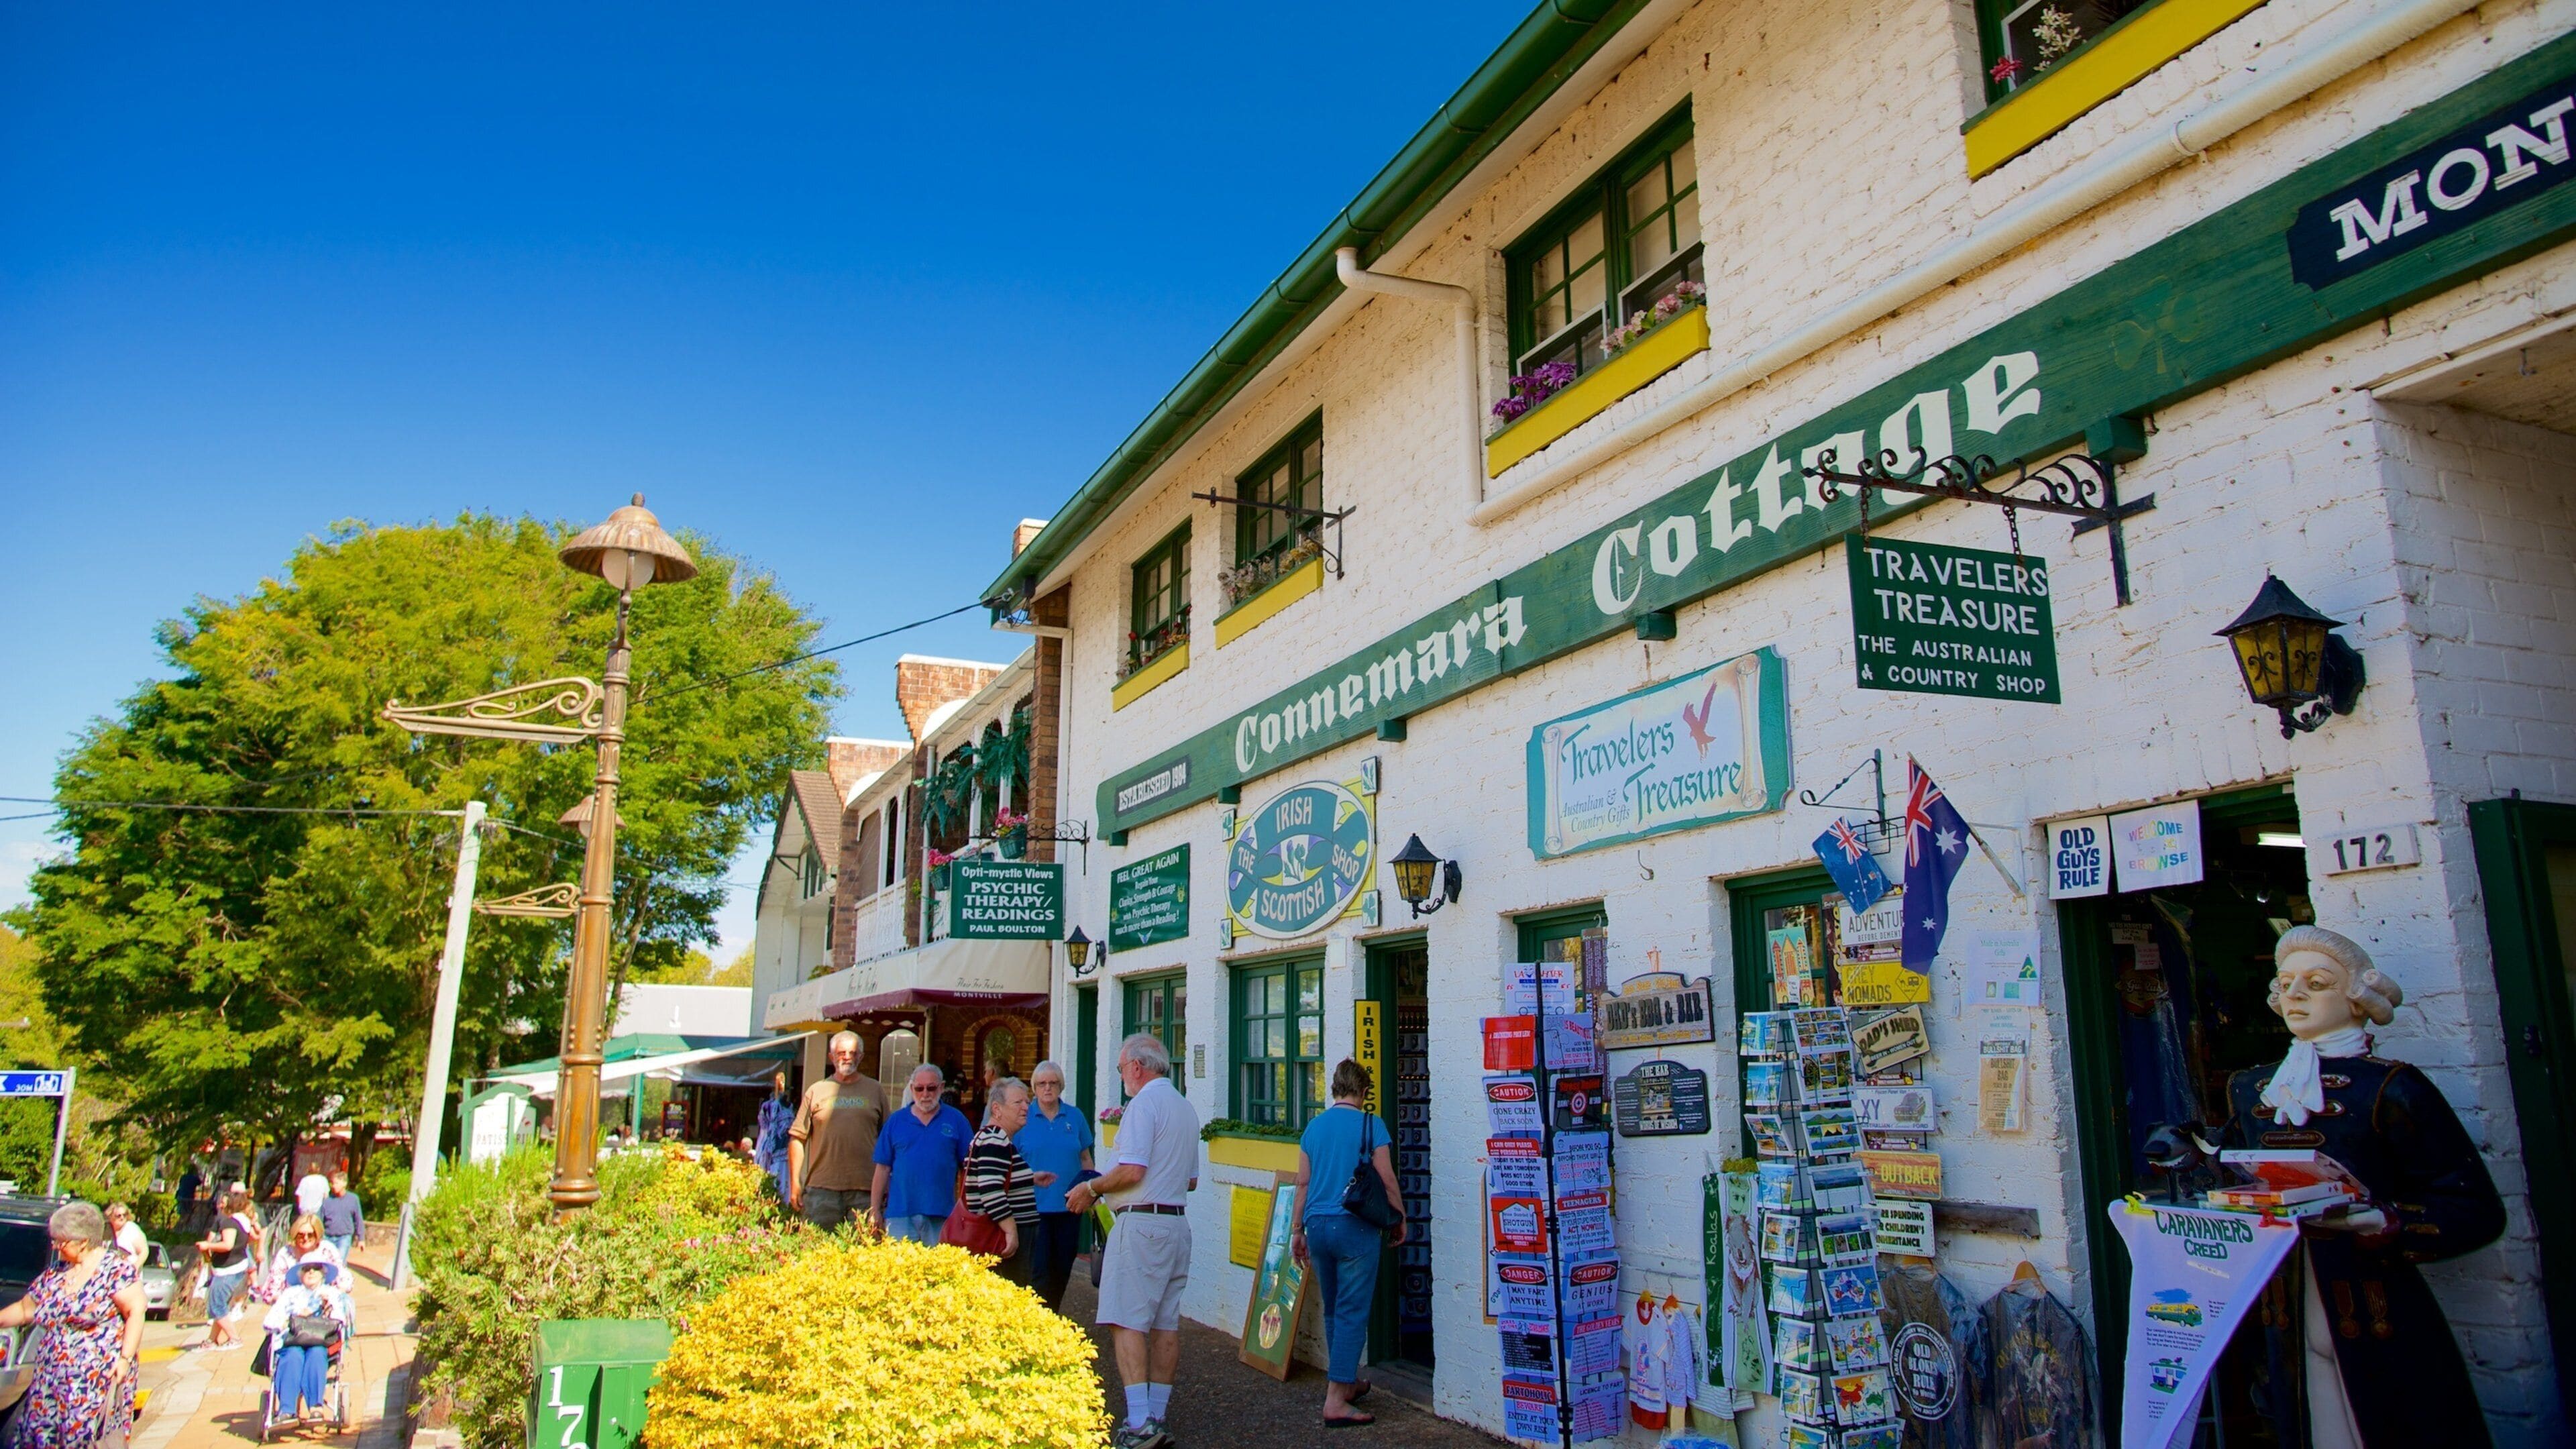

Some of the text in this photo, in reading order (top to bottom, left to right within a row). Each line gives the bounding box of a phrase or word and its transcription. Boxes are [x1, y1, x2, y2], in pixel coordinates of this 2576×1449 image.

[2330, 96, 2576, 262] MON
[1592, 350, 2041, 614] Cottage
[1869, 547, 2048, 596] TRAVELERS
[1874, 589, 2039, 635] TREASURE
[1858, 635, 2031, 666] THE AUSTRALIAN
[1236, 596, 1528, 773] Connemara
[1861, 666, 2046, 696] & COUNTRY SHOP
[1562, 717, 1674, 784] Travelers
[1118, 771, 1170, 812] ESTABLISHED
[1623, 761, 1741, 824] Treasure
[1560, 788, 1617, 818] Australian &
[1276, 796, 1312, 833] IRISH
[1572, 805, 1631, 833] Country Gifts
[2060, 826, 2095, 849] OLD
[2129, 820, 2183, 842] WELCOME
[1238, 847, 1255, 875] THE
[2057, 847, 2100, 870] GUYS
[2129, 851, 2189, 871] BROWSE
[2333, 833, 2394, 870] 172
[962, 866, 1054, 879] Opti-mystic Views
[1117, 852, 1179, 883] FEEL GREAT AGAIN
[1332, 844, 1360, 882] SHOP
[971, 882, 1044, 895] PSYCHIC
[2059, 869, 2101, 890] RULE
[964, 895, 1053, 908] THERAPY/
[1152, 888, 1157, 898] &
[1261, 877, 1325, 922] SCOTTISH
[962, 909, 1055, 921] READINGS
[1132, 906, 1150, 918] Psychic
[1150, 901, 1171, 913] Therapy
[998, 925, 1045, 933] BOULTON
[1858, 933, 1878, 941] BEFORE
[1847, 965, 1874, 984] GREY
[1847, 985, 1892, 1003] NOMADS
[1665, 1000, 1674, 1024] &
[1676, 991, 1703, 1024] BAR
[1362, 1006, 1375, 1059] IRISH
[1859, 1017, 1920, 1051] DAD'S SHED
[1889, 1044, 1907, 1055] WOMEN
[1983, 1045, 2022, 1053] BULLSHIT BAG
[1366, 1066, 1373, 1074] &
[1640, 1064, 1669, 1078] THE BAR
[1494, 1088, 1529, 1097] CAUTION
[1493, 1107, 1512, 1115] GONE
[1861, 1099, 1880, 1120] XY
[1881, 1164, 1937, 1185] OUTBACK
[1562, 1197, 1601, 1208] TEENAGERS
[1890, 1210, 1925, 1221] SPENDING
[1885, 1222, 1925, 1234] CHILDREN'S
[2155, 1210, 2253, 1243] CARAVANERS
[1707, 1209, 1719, 1266] Koalas
[2184, 1238, 2228, 1259] CREED
[1505, 1269, 1540, 1281] DANGER
[1577, 1267, 1611, 1279] CAUTION
[1511, 1296, 1547, 1307] ANYTIME
[1572, 1285, 1613, 1299] GENIUS
[1587, 1299, 1605, 1307] WORK
[1914, 1343, 1931, 1358] OLD
[1909, 1356, 1938, 1375] BLOKES
[1580, 1386, 1601, 1395] LICENCE
[1610, 1380, 1623, 1388] FART
[1913, 1373, 1935, 1391] RULE
[1506, 1385, 1552, 1401] FARTOHOLIC
[547, 1364, 588, 1449] 17
[1516, 1401, 1543, 1412] BEWARE
[1508, 1411, 1527, 1421] ENTER
[1539, 1417, 1554, 1426] YOUR
[1517, 1423, 1548, 1434] OWN RISK
